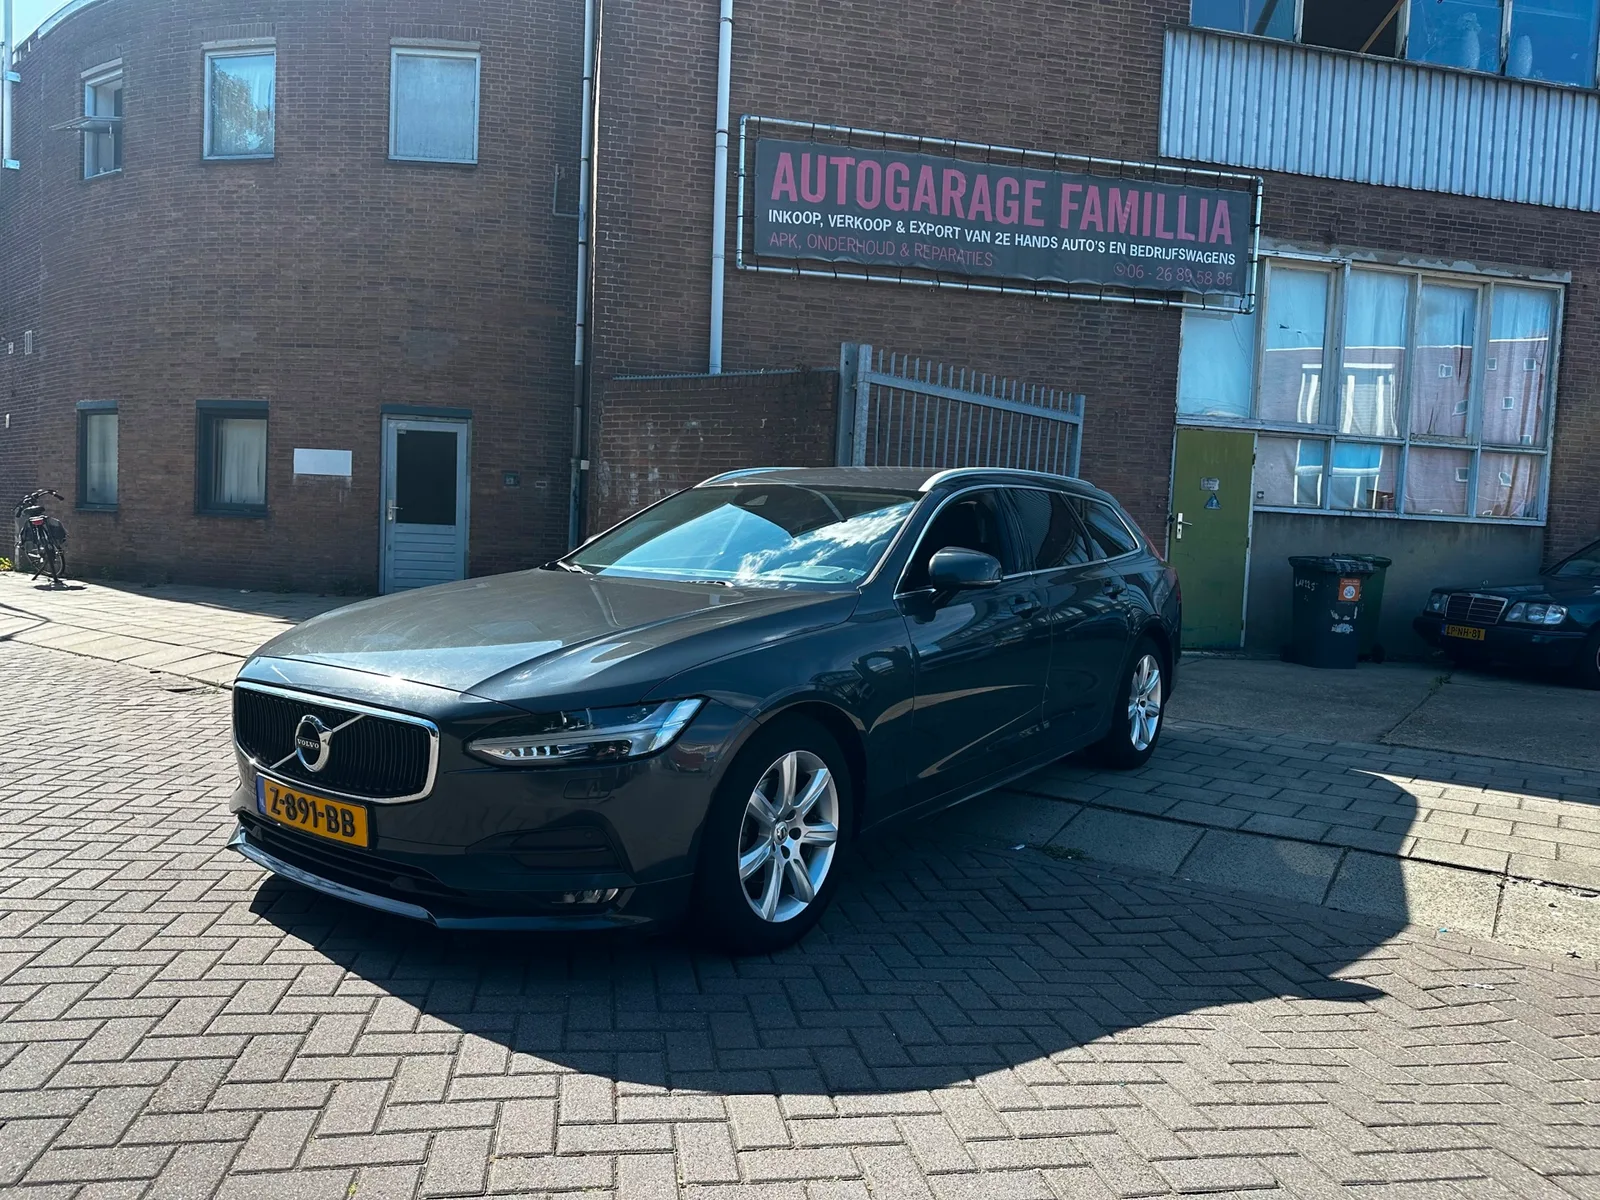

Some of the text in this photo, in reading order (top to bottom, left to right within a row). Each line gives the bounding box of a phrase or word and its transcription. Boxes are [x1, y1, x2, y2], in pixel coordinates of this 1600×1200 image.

[771, 152, 1232, 245] AUTOGARAGE FAMILLIA
[768, 209, 1236, 265] INKOOP, VERKOOP & EXPORT VAN 2E HANDS AUTO'S EN BEDRIJFSWAGENS
[769, 231, 993, 267] APK, ONDERHOUD & REPARATIES
[1127, 263, 1144, 279] 06
[1156, 266, 1173, 281] 26
[1175, 267, 1193, 283] 89
[1196, 270, 1213, 285] 58
[1216, 271, 1233, 287] 85
[297, 738, 319, 748] VOLVO
[270, 787, 355, 837] Z-891-BB
